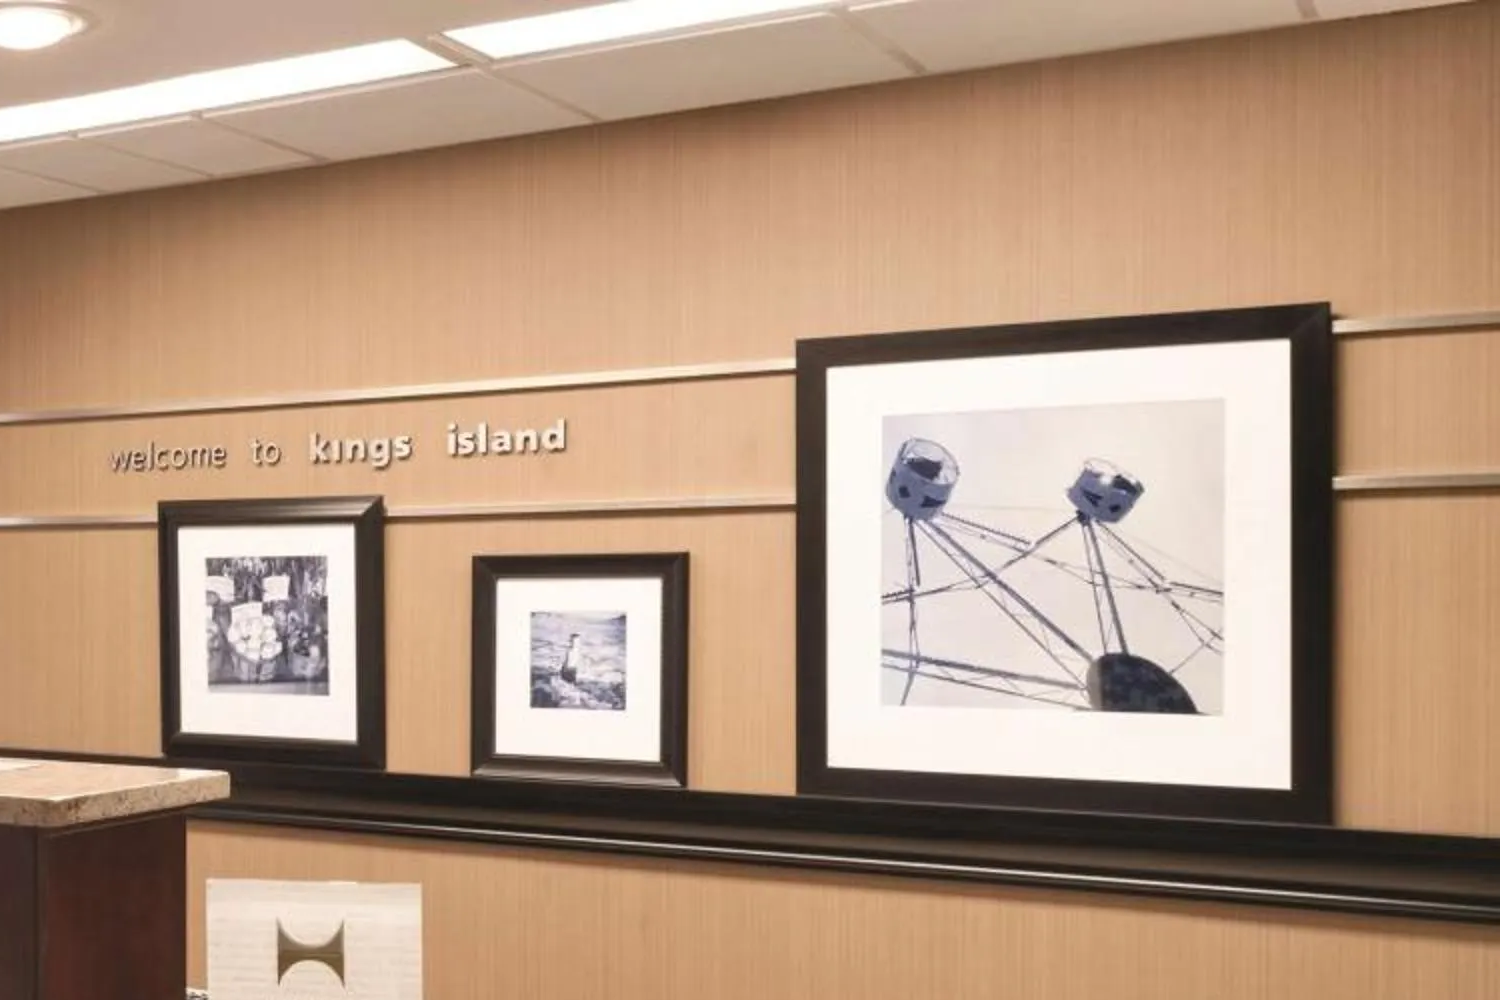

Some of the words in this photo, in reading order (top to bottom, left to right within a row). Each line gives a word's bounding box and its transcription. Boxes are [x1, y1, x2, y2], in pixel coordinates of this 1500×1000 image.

[109, 441, 228, 472] welcome
[250, 438, 282, 465] to
[308, 432, 412, 468] kings
[446, 418, 567, 456] island
